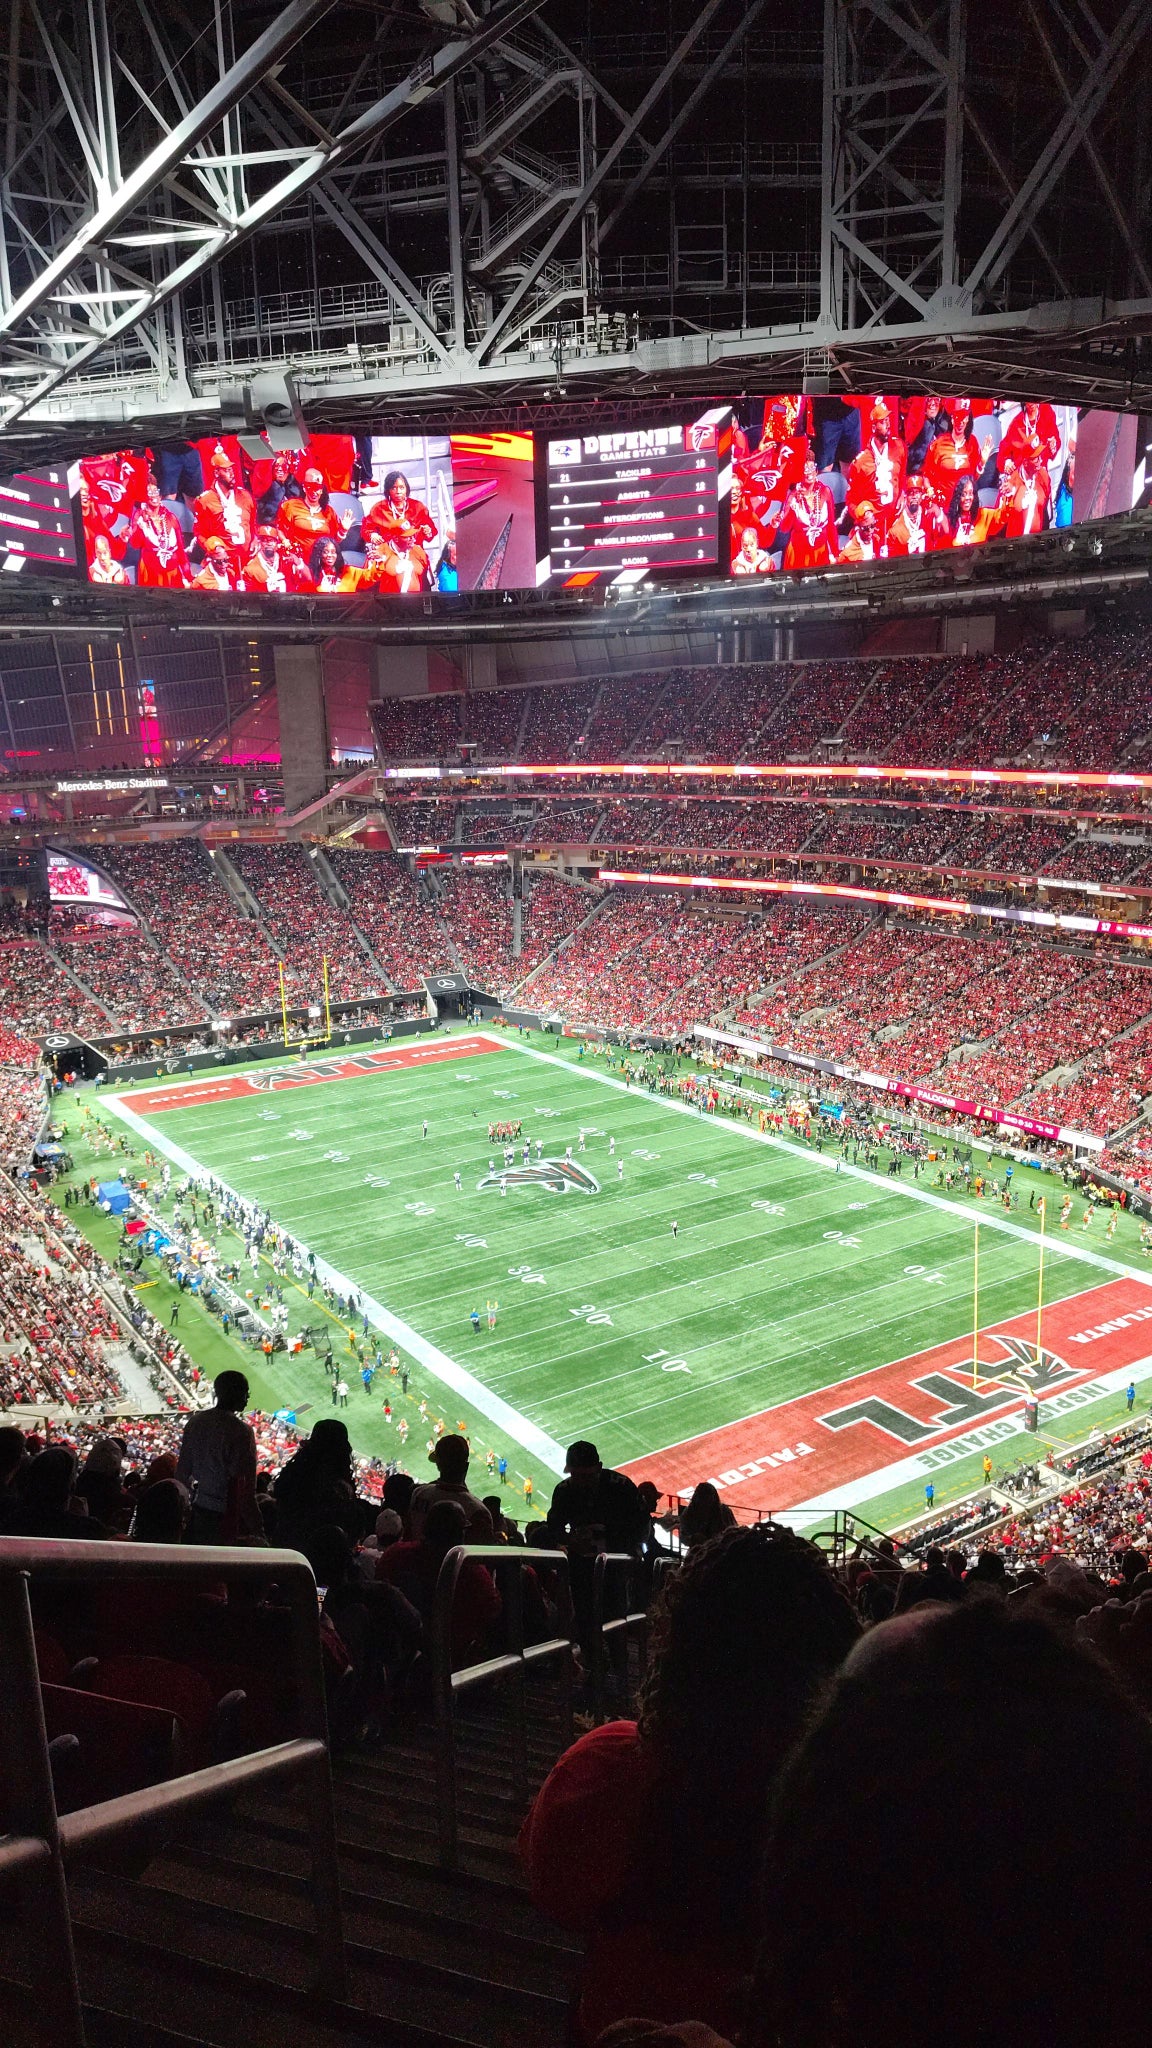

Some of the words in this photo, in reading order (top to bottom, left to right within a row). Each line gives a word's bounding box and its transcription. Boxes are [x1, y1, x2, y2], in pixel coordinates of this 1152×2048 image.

[583, 425, 683, 454] DEFENSE
[600, 450, 631, 461] GAME
[633, 447, 667, 458] STATS
[560, 473, 570, 483] 21
[616, 468, 652, 478] TACKLES
[603, 511, 665, 524] INTERCEPTIONS
[621, 556, 649, 566] SACKS
[57, 780, 128, 791] Mercedes-Benz
[129, 778, 168, 788] Stadium
[247, 1057, 404, 1092] ATL
[148, 1086, 232, 1105] ATLANTA
[917, 1090, 956, 1107] FALCONS
[404, 1201, 436, 1216] 50
[508, 1265, 546, 1284] 30
[903, 1265, 947, 1286] 10
[568, 1304, 611, 1325] 20
[641, 1348, 687, 1372] 10
[813, 1334, 1097, 1447] ATL
[916, 1422, 1018, 1468] CHANGE
